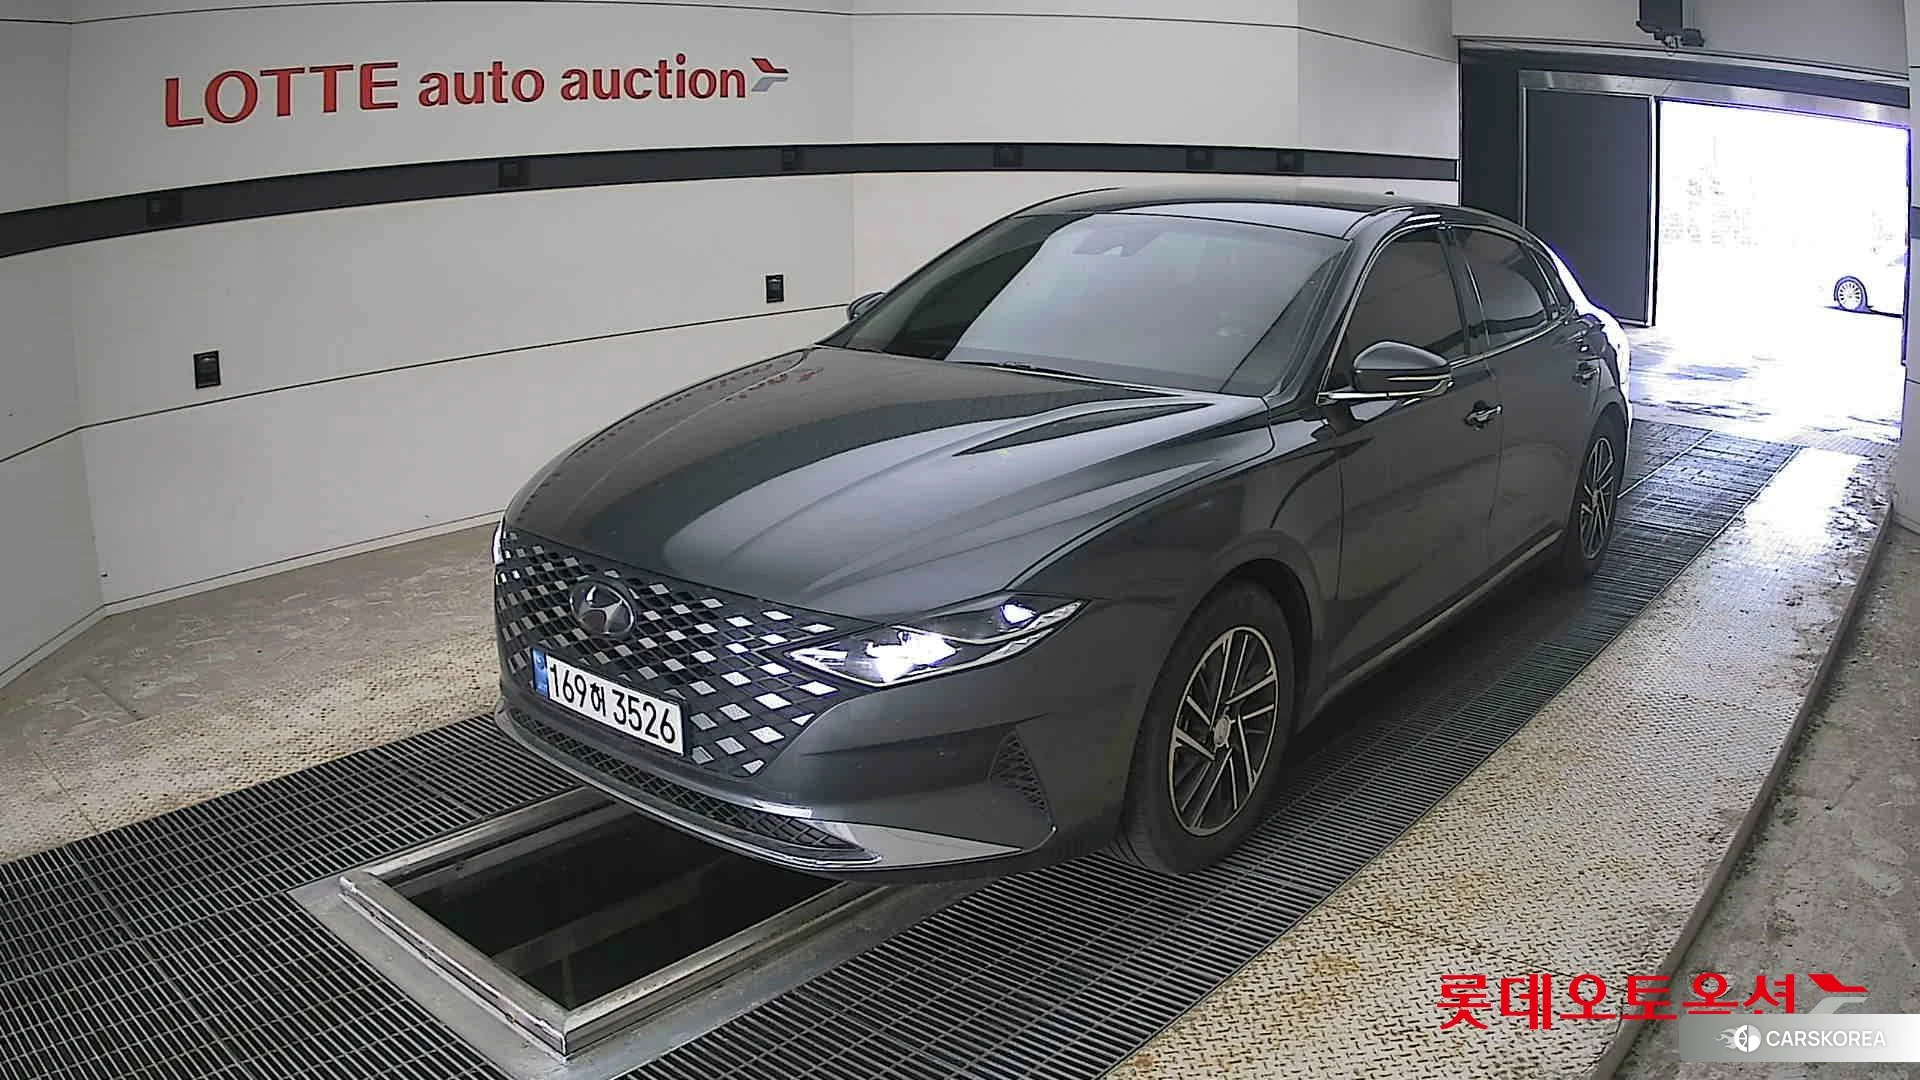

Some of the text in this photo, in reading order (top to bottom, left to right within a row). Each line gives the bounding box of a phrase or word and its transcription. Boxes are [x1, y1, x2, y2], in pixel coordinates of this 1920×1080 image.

[165, 53, 746, 127] LOTTE auto auction
[612, 689, 676, 744] 3526
